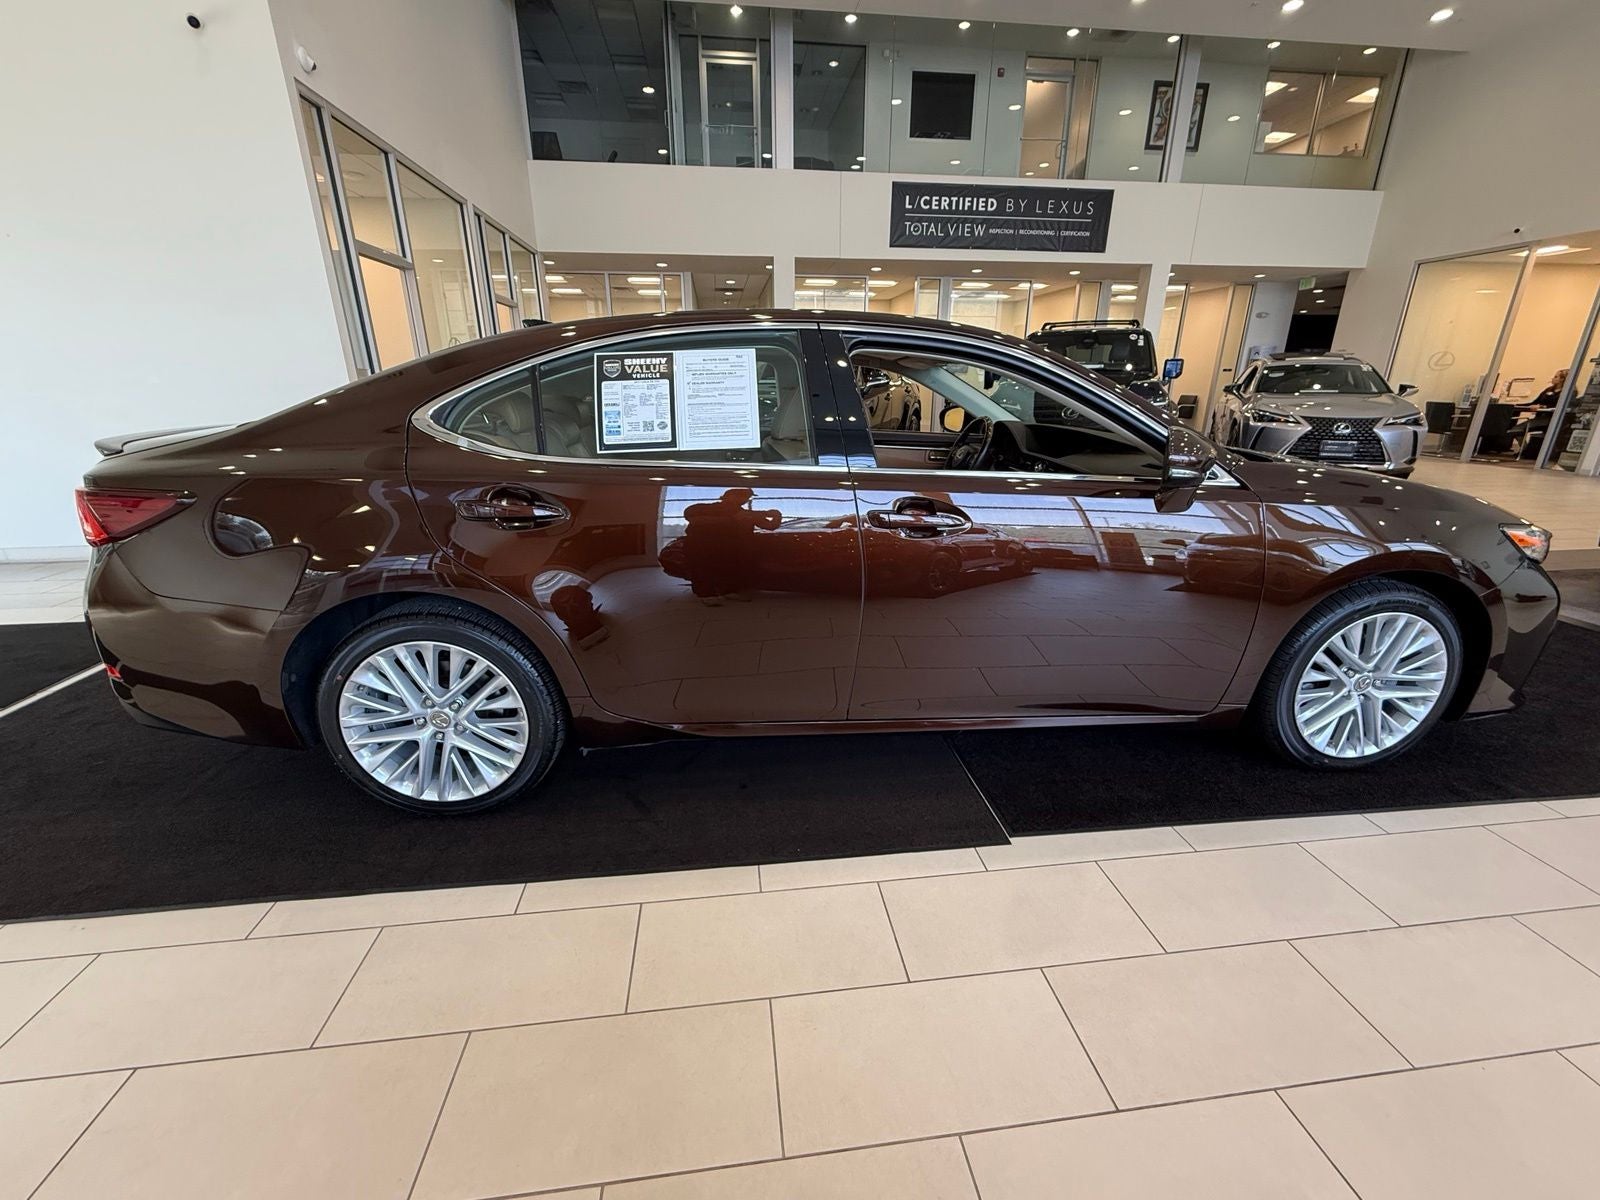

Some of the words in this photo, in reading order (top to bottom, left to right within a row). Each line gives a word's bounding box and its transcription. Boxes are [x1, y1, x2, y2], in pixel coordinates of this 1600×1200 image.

[905, 195, 997, 211] L/CERTIFIED
[1005, 198, 1028, 213] BY
[1035, 200, 1095, 215] LEXUS
[904, 222, 945, 236] TOTAL
[947, 223, 986, 237] VIEW
[1018, 229, 1057, 237] RECONDITIONING
[624, 364, 669, 374] VALUE
